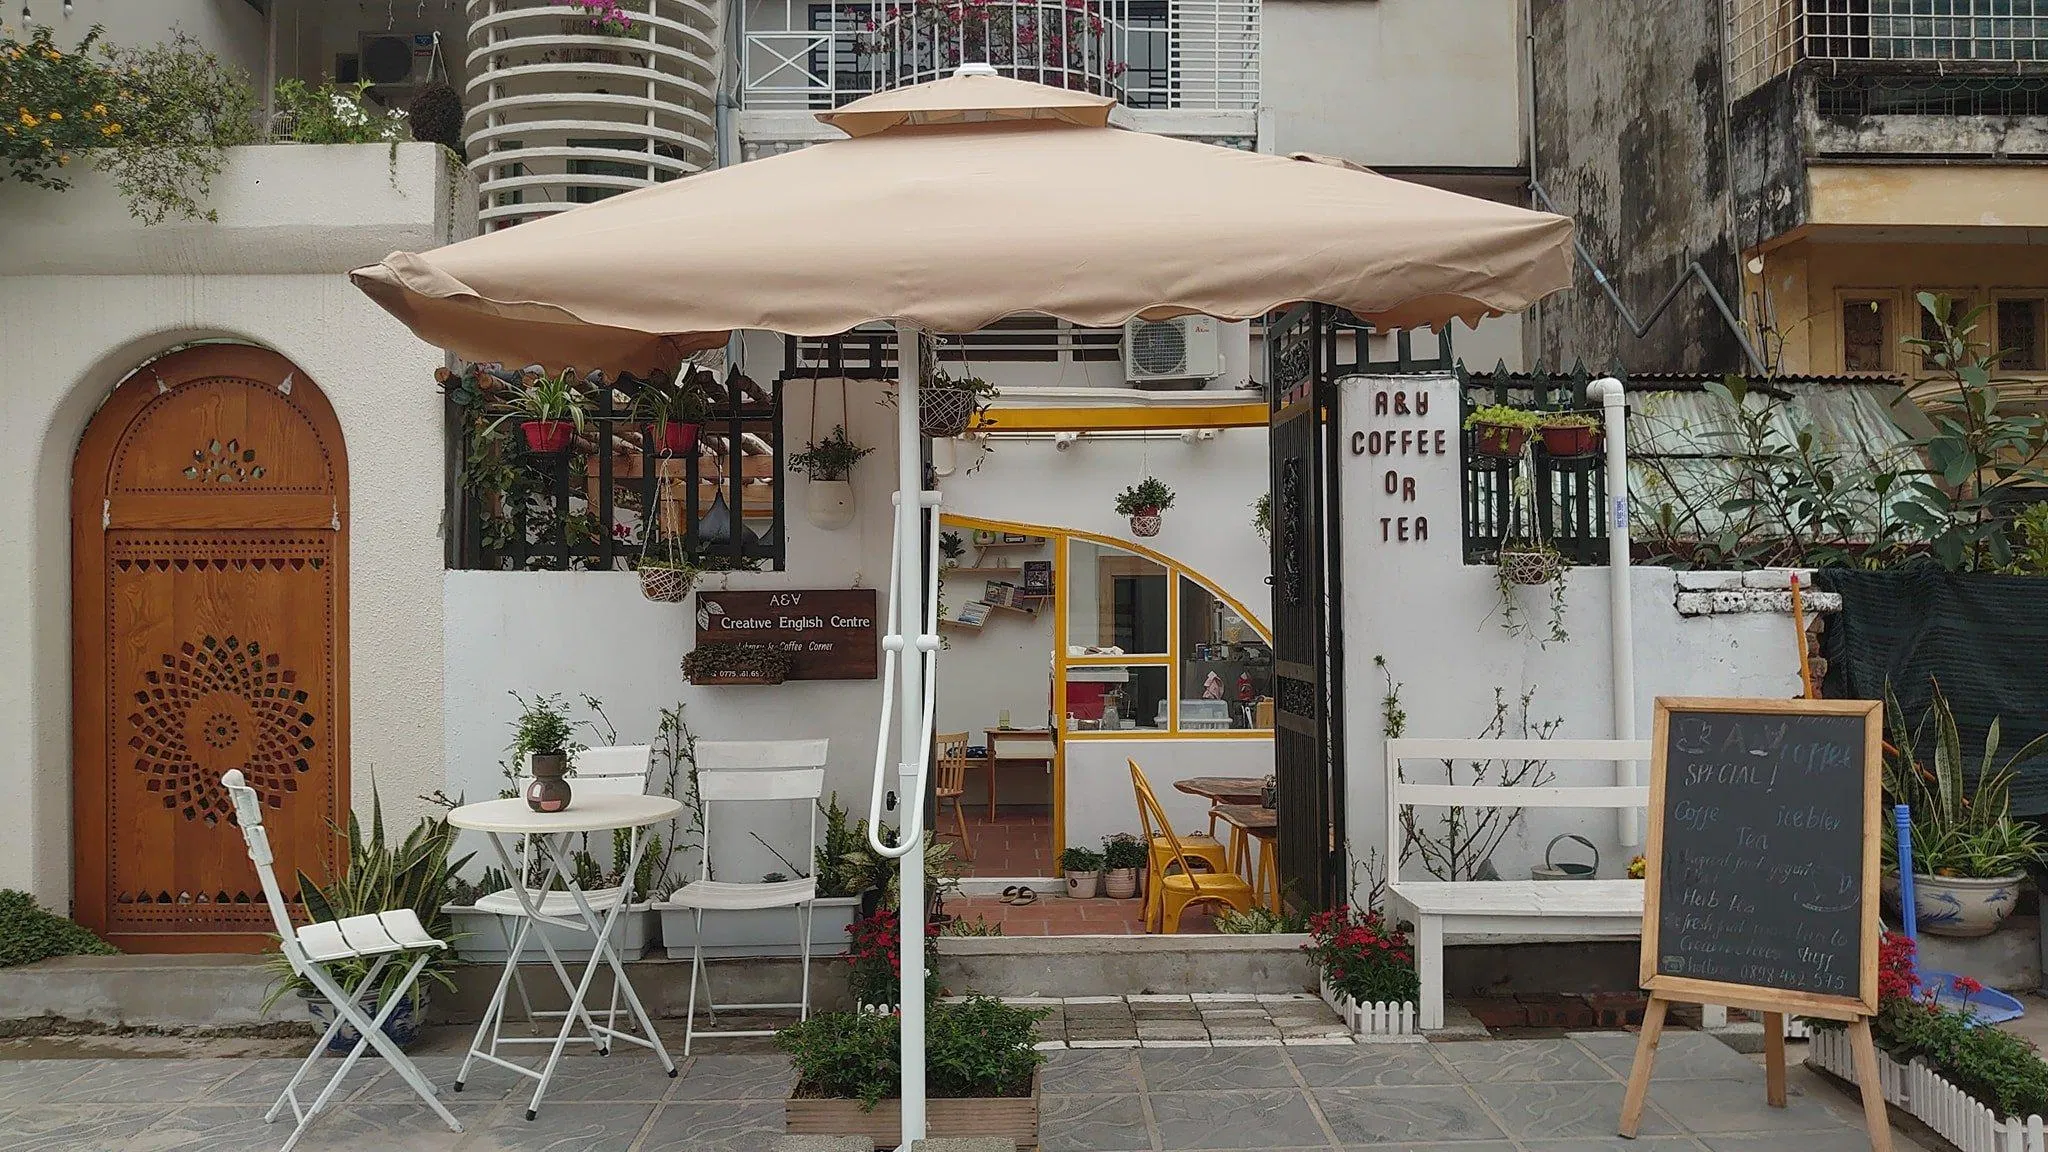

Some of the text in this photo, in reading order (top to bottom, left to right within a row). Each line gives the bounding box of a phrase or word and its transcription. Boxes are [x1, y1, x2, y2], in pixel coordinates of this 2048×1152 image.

[1351, 430, 1446, 455] COFFEE
[1385, 470, 1416, 502] OR
[1380, 516, 1428, 542] TEA
[721, 615, 870, 631] Creative English Centre
[780, 640, 802, 651] Coffee
[808, 641, 833, 651] Corner
